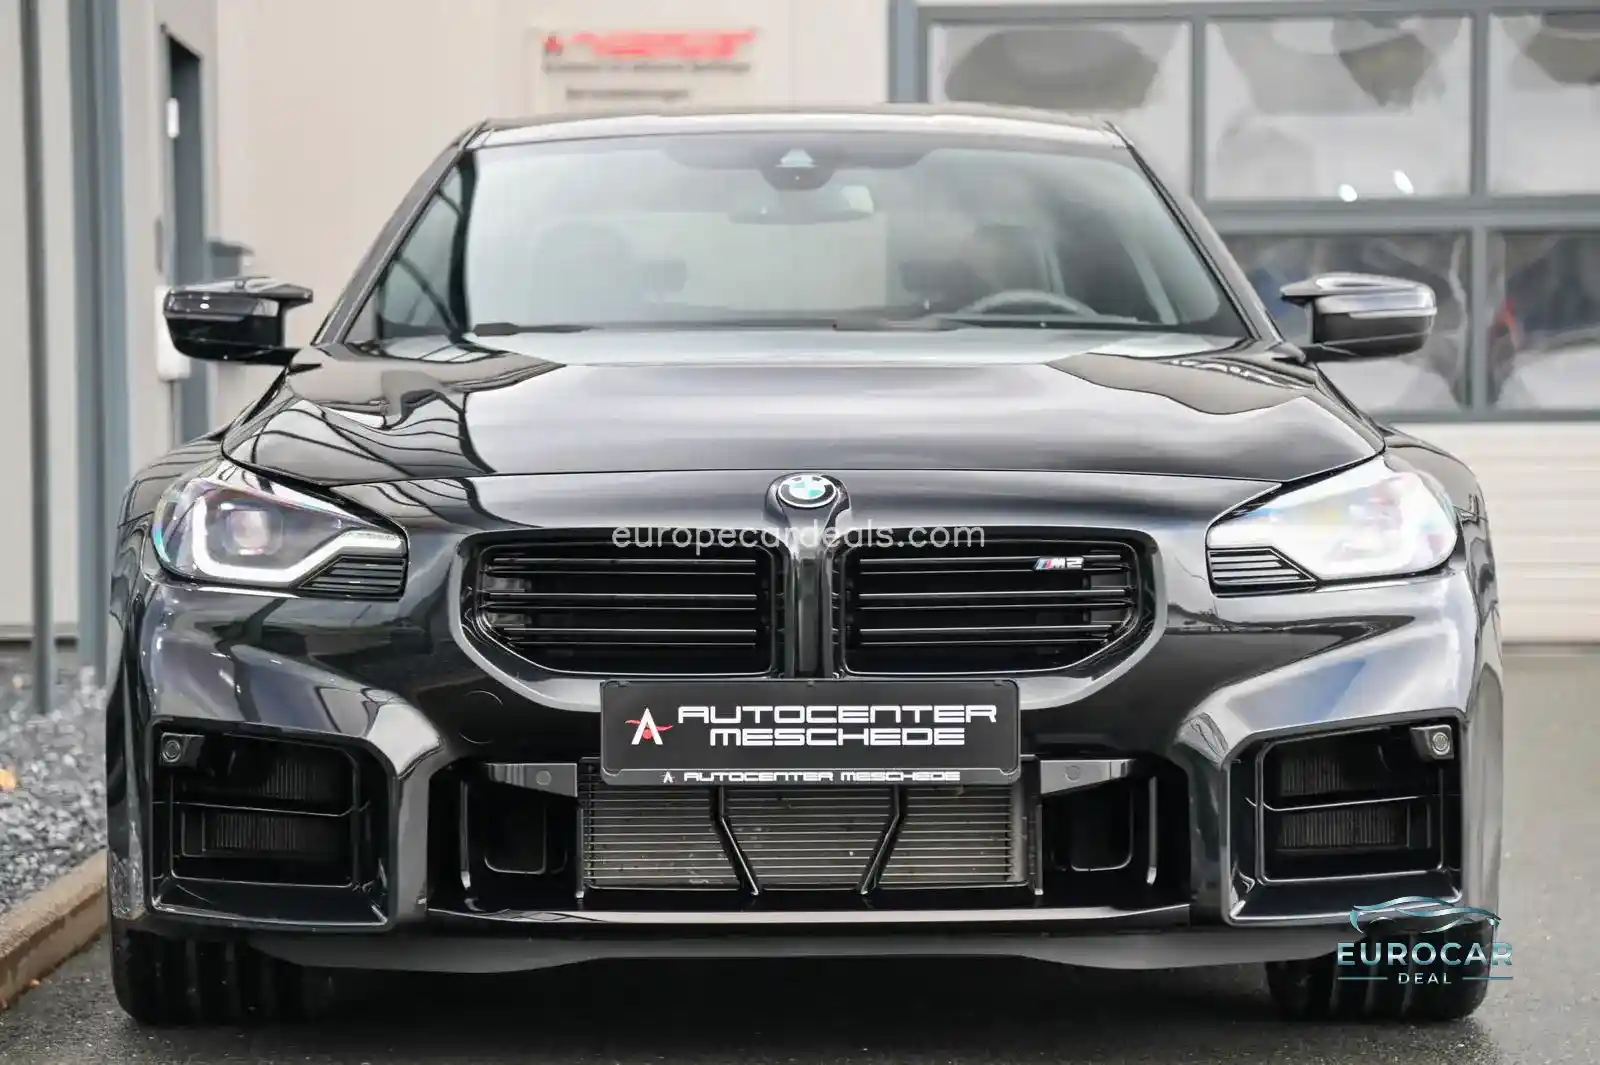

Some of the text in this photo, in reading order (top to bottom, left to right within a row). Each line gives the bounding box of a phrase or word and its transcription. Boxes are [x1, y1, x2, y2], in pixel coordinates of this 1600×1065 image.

[677, 705, 997, 724] AUTOCENTER
[709, 728, 966, 747] MESCHEDE
[683, 771, 834, 782] AUTOCENTER
[840, 771, 961, 782] MESCHEDE
